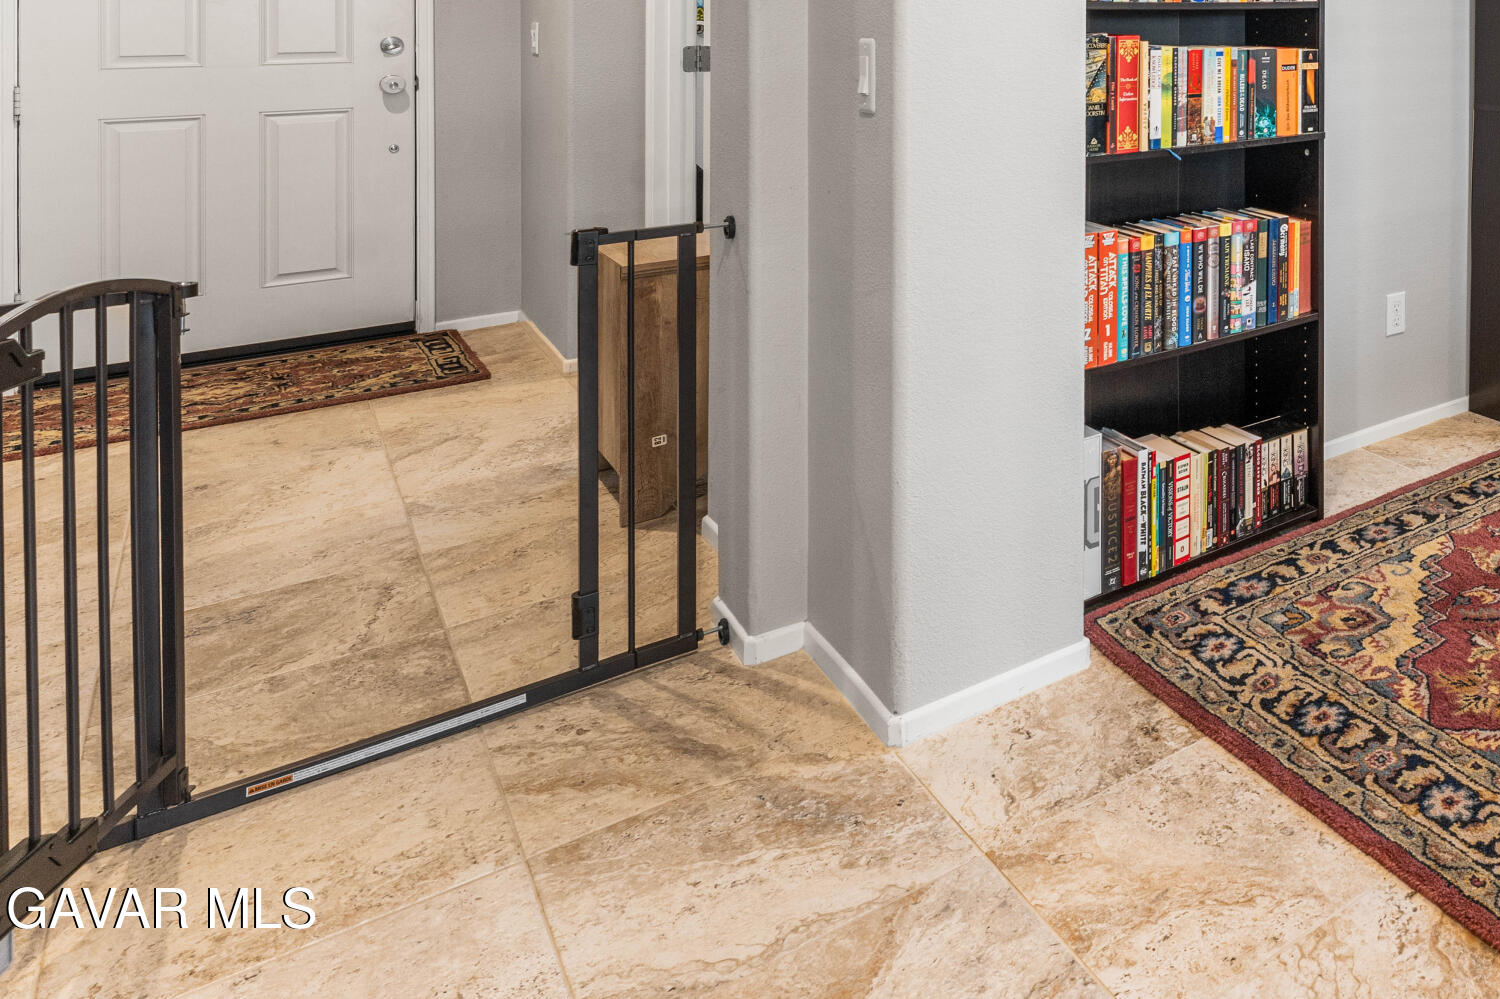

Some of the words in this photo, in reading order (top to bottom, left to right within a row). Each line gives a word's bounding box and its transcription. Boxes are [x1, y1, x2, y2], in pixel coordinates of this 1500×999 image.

[1088, 255, 1097, 292] ATTACK
[1100, 265, 1109, 296] TITAN
[1108, 251, 1117, 288] ATTACK
[1144, 251, 1153, 283] VAMPIRES
[1144, 291, 1152, 299] EL
[1144, 300, 1152, 321] NORTE
[1172, 298, 1178, 306] IN
